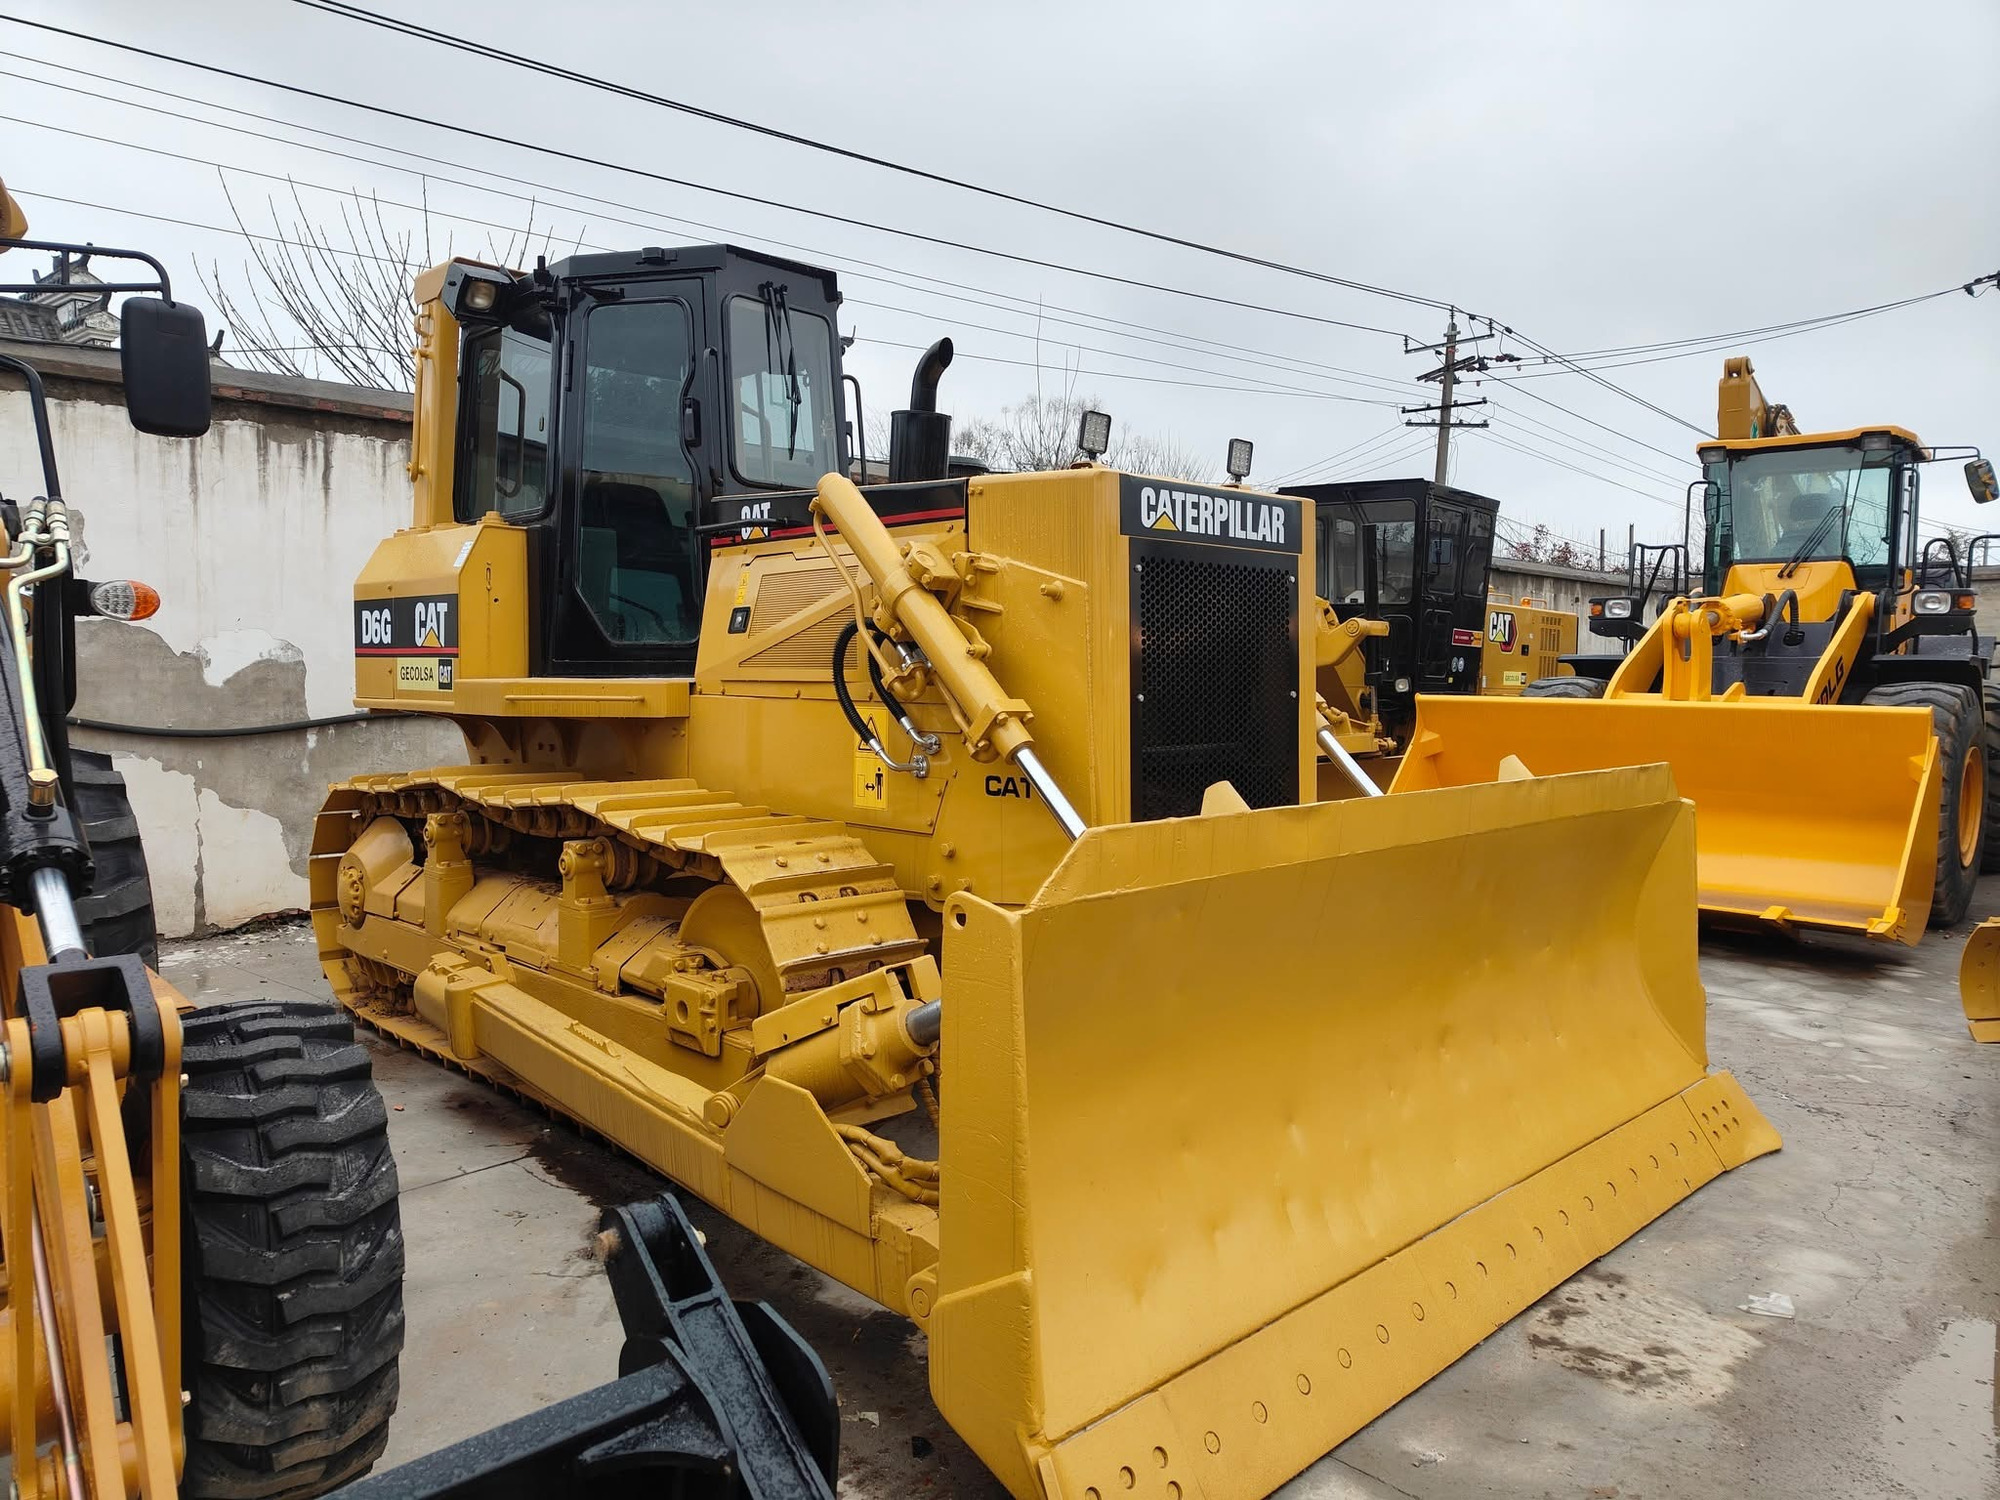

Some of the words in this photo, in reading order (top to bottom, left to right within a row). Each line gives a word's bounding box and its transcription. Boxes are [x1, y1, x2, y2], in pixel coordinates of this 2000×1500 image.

[740, 501, 771, 540] CAT
[1140, 486, 1286, 544] CATERPILLAR
[361, 608, 392, 645] D6G
[414, 602, 448, 648] CAT
[1489, 612, 1512, 642] CAT
[399, 666, 434, 681] GECOLSA
[439, 665, 451, 684] CAT
[1815, 655, 1844, 704] DLG
